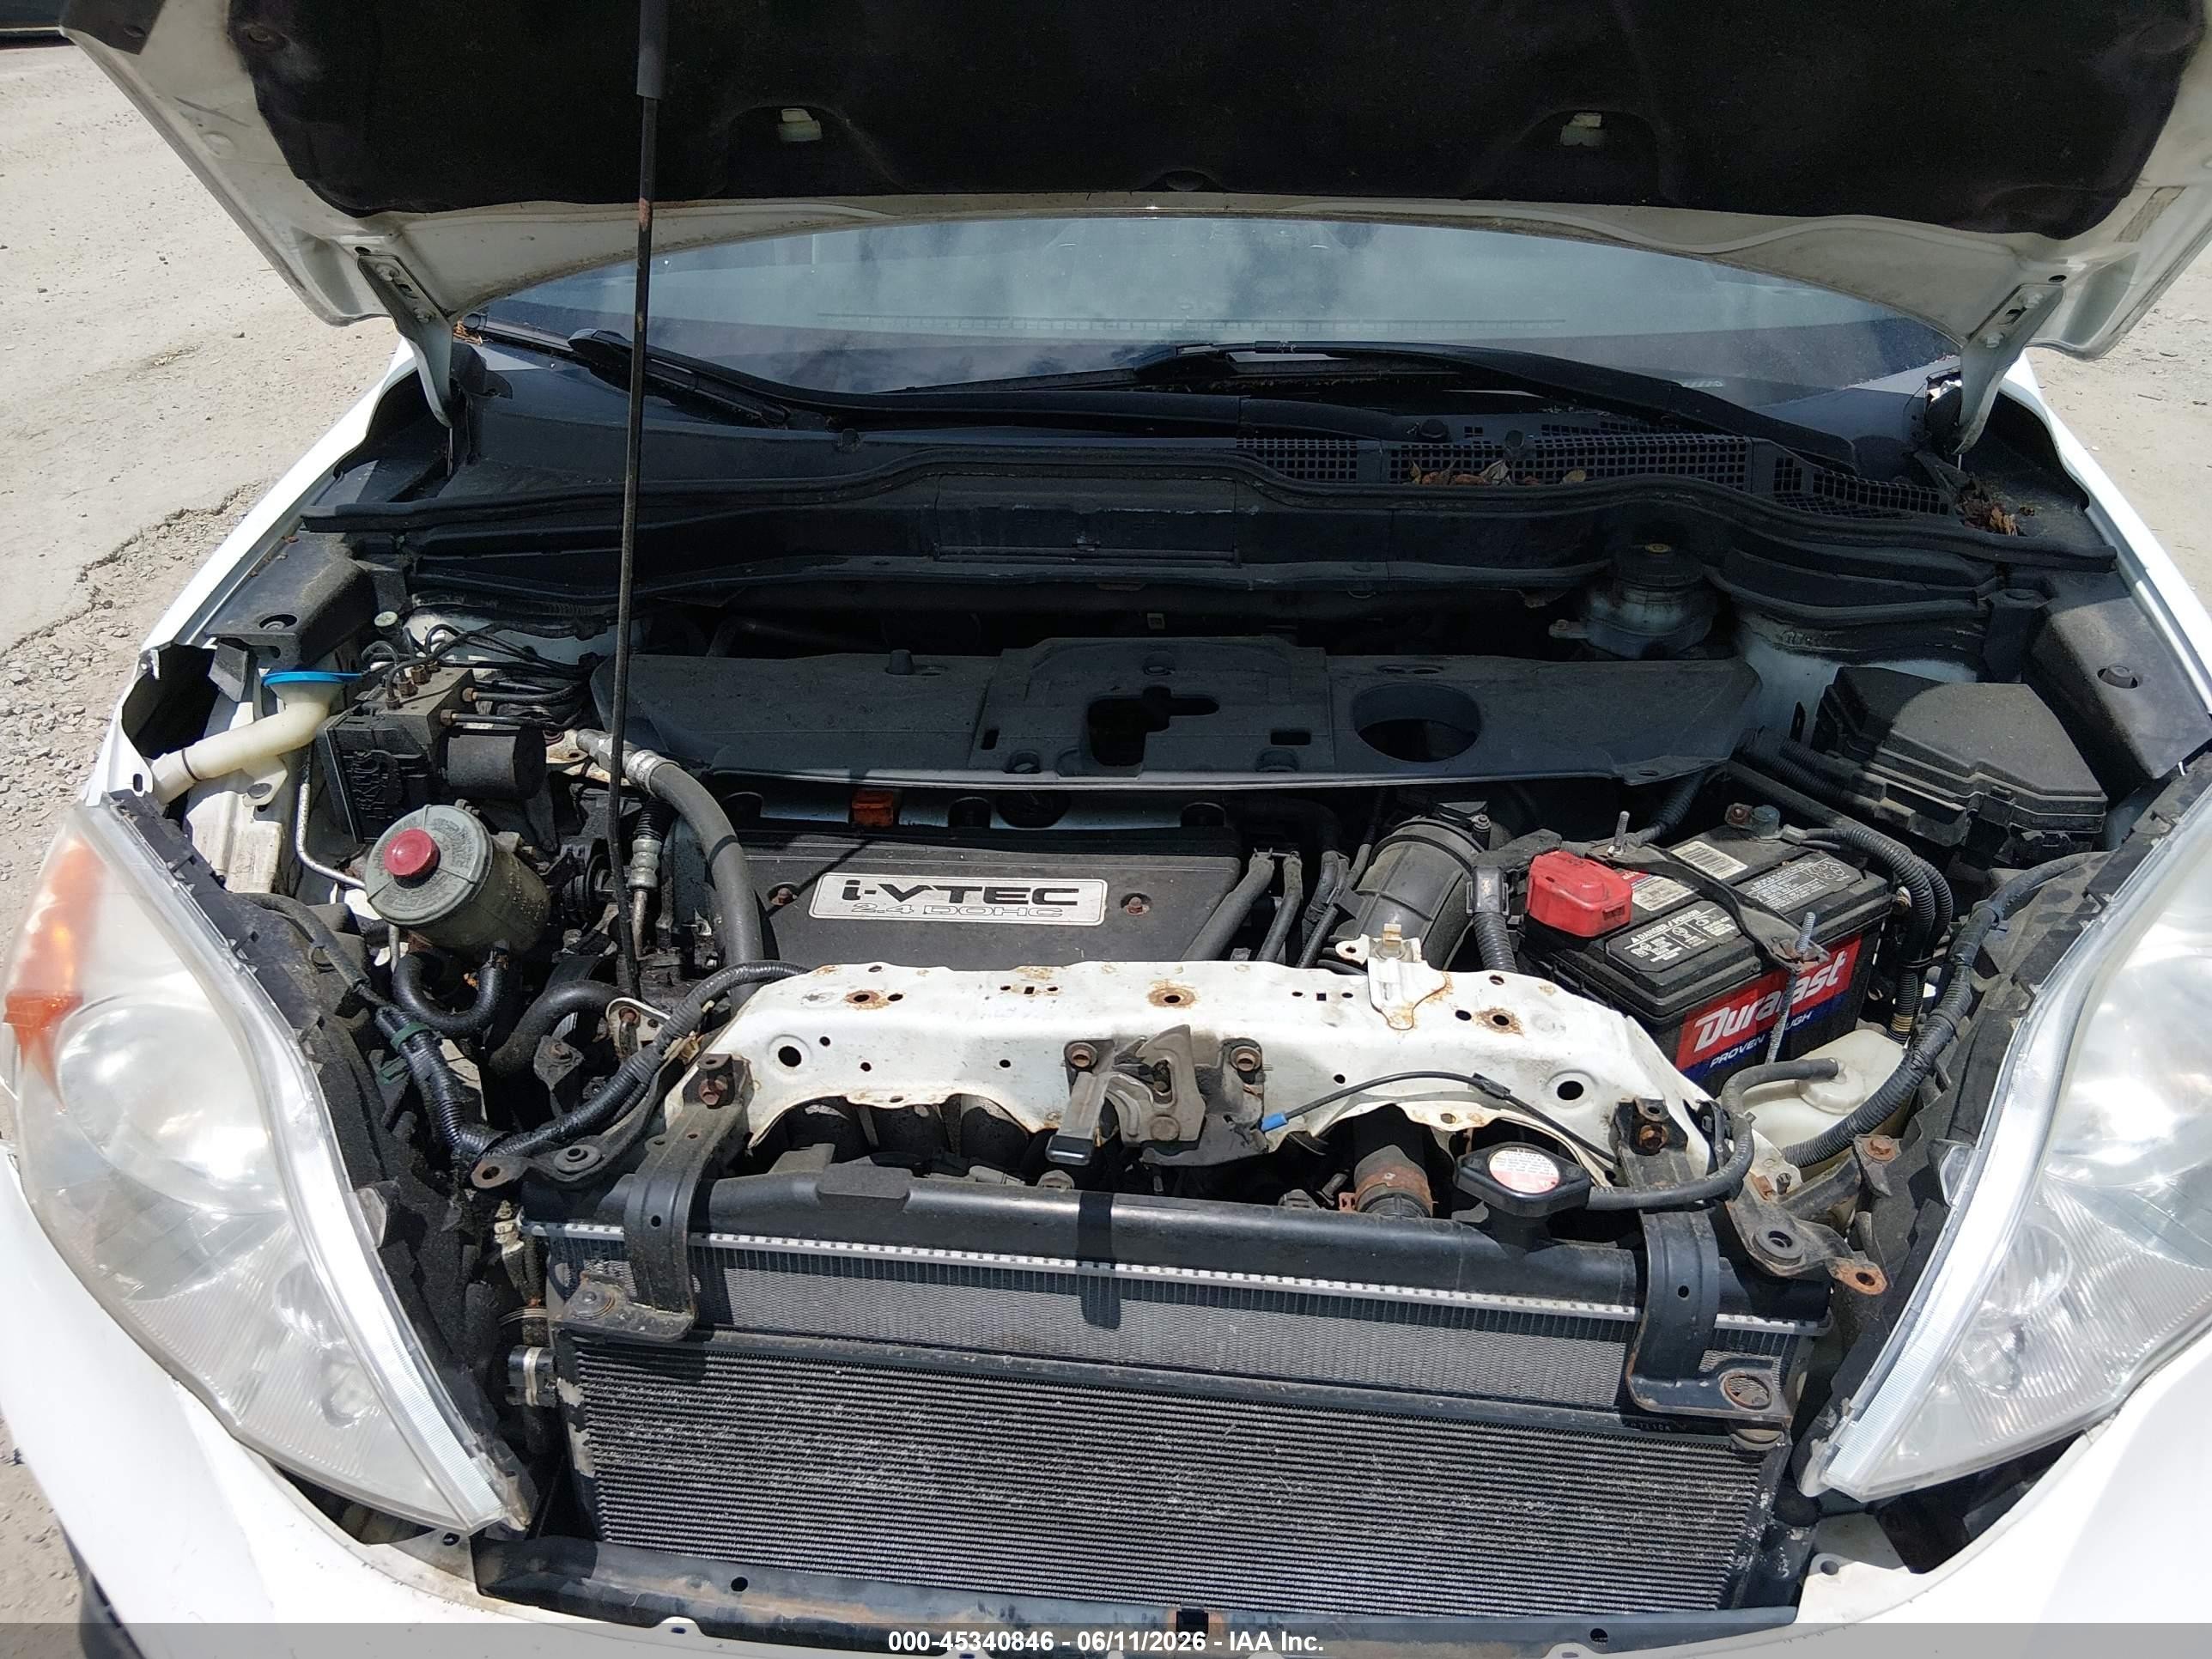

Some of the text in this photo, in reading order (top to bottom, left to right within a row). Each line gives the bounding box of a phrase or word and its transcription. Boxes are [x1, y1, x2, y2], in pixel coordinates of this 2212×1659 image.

[842, 879, 1079, 906] i-VTEC
[851, 902, 1064, 918] 2.4 DOHC
[1637, 923, 1669, 939] DANGER
[1693, 950, 1847, 1053] Duraast
[1710, 1035, 1765, 1069] PROVEN
